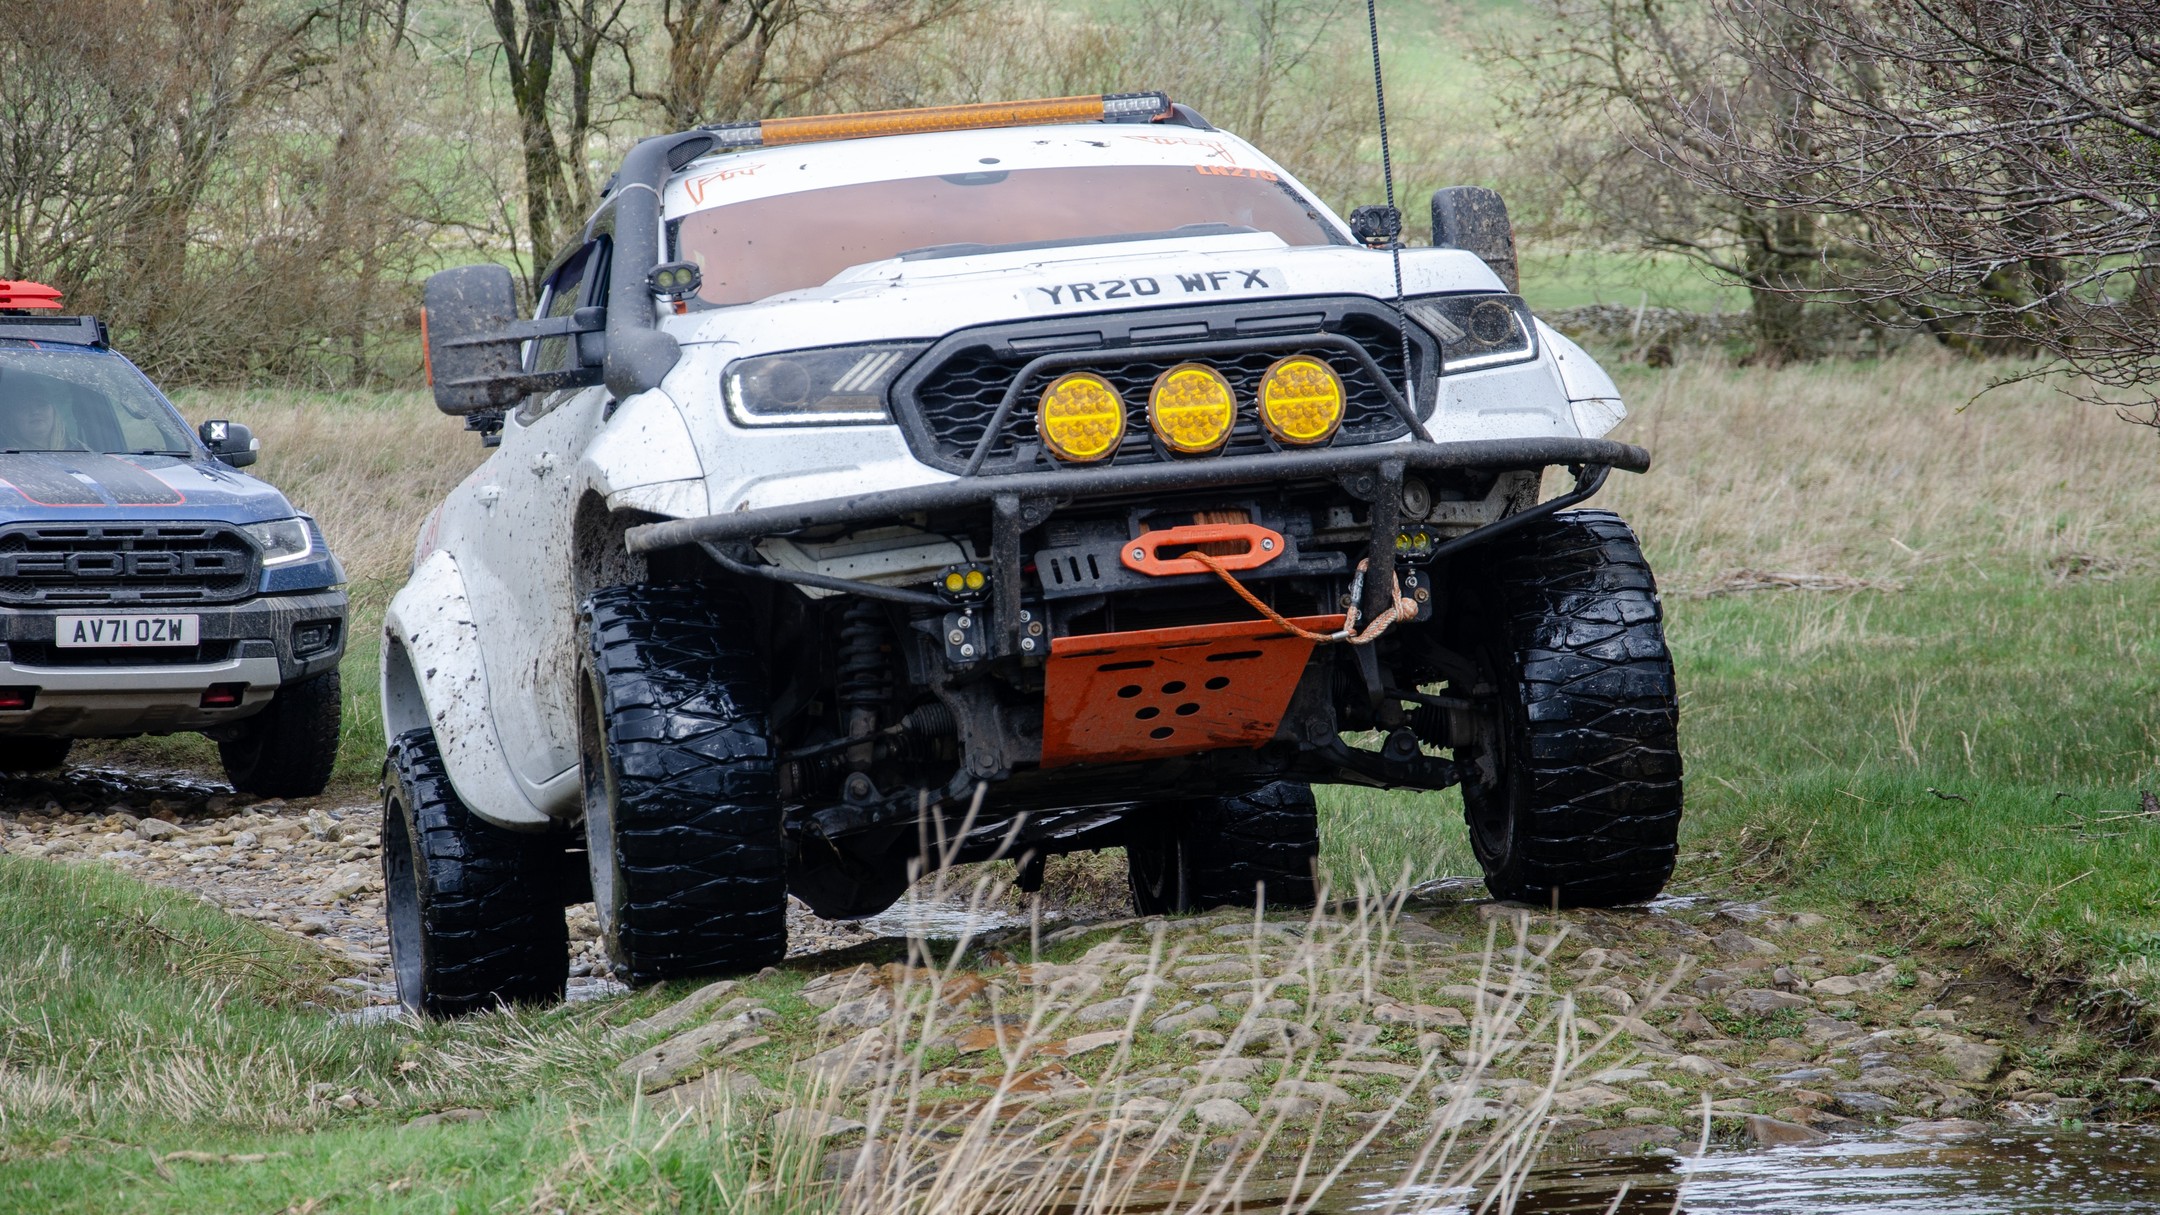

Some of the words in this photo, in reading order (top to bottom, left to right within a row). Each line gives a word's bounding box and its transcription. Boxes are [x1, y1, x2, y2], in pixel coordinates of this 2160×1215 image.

[1037, 276, 1161, 305] YR20
[1175, 269, 1269, 293] WFX
[5, 551, 240, 577] FORD
[73, 618, 128, 643] AV71
[135, 618, 182, 642] OZW
